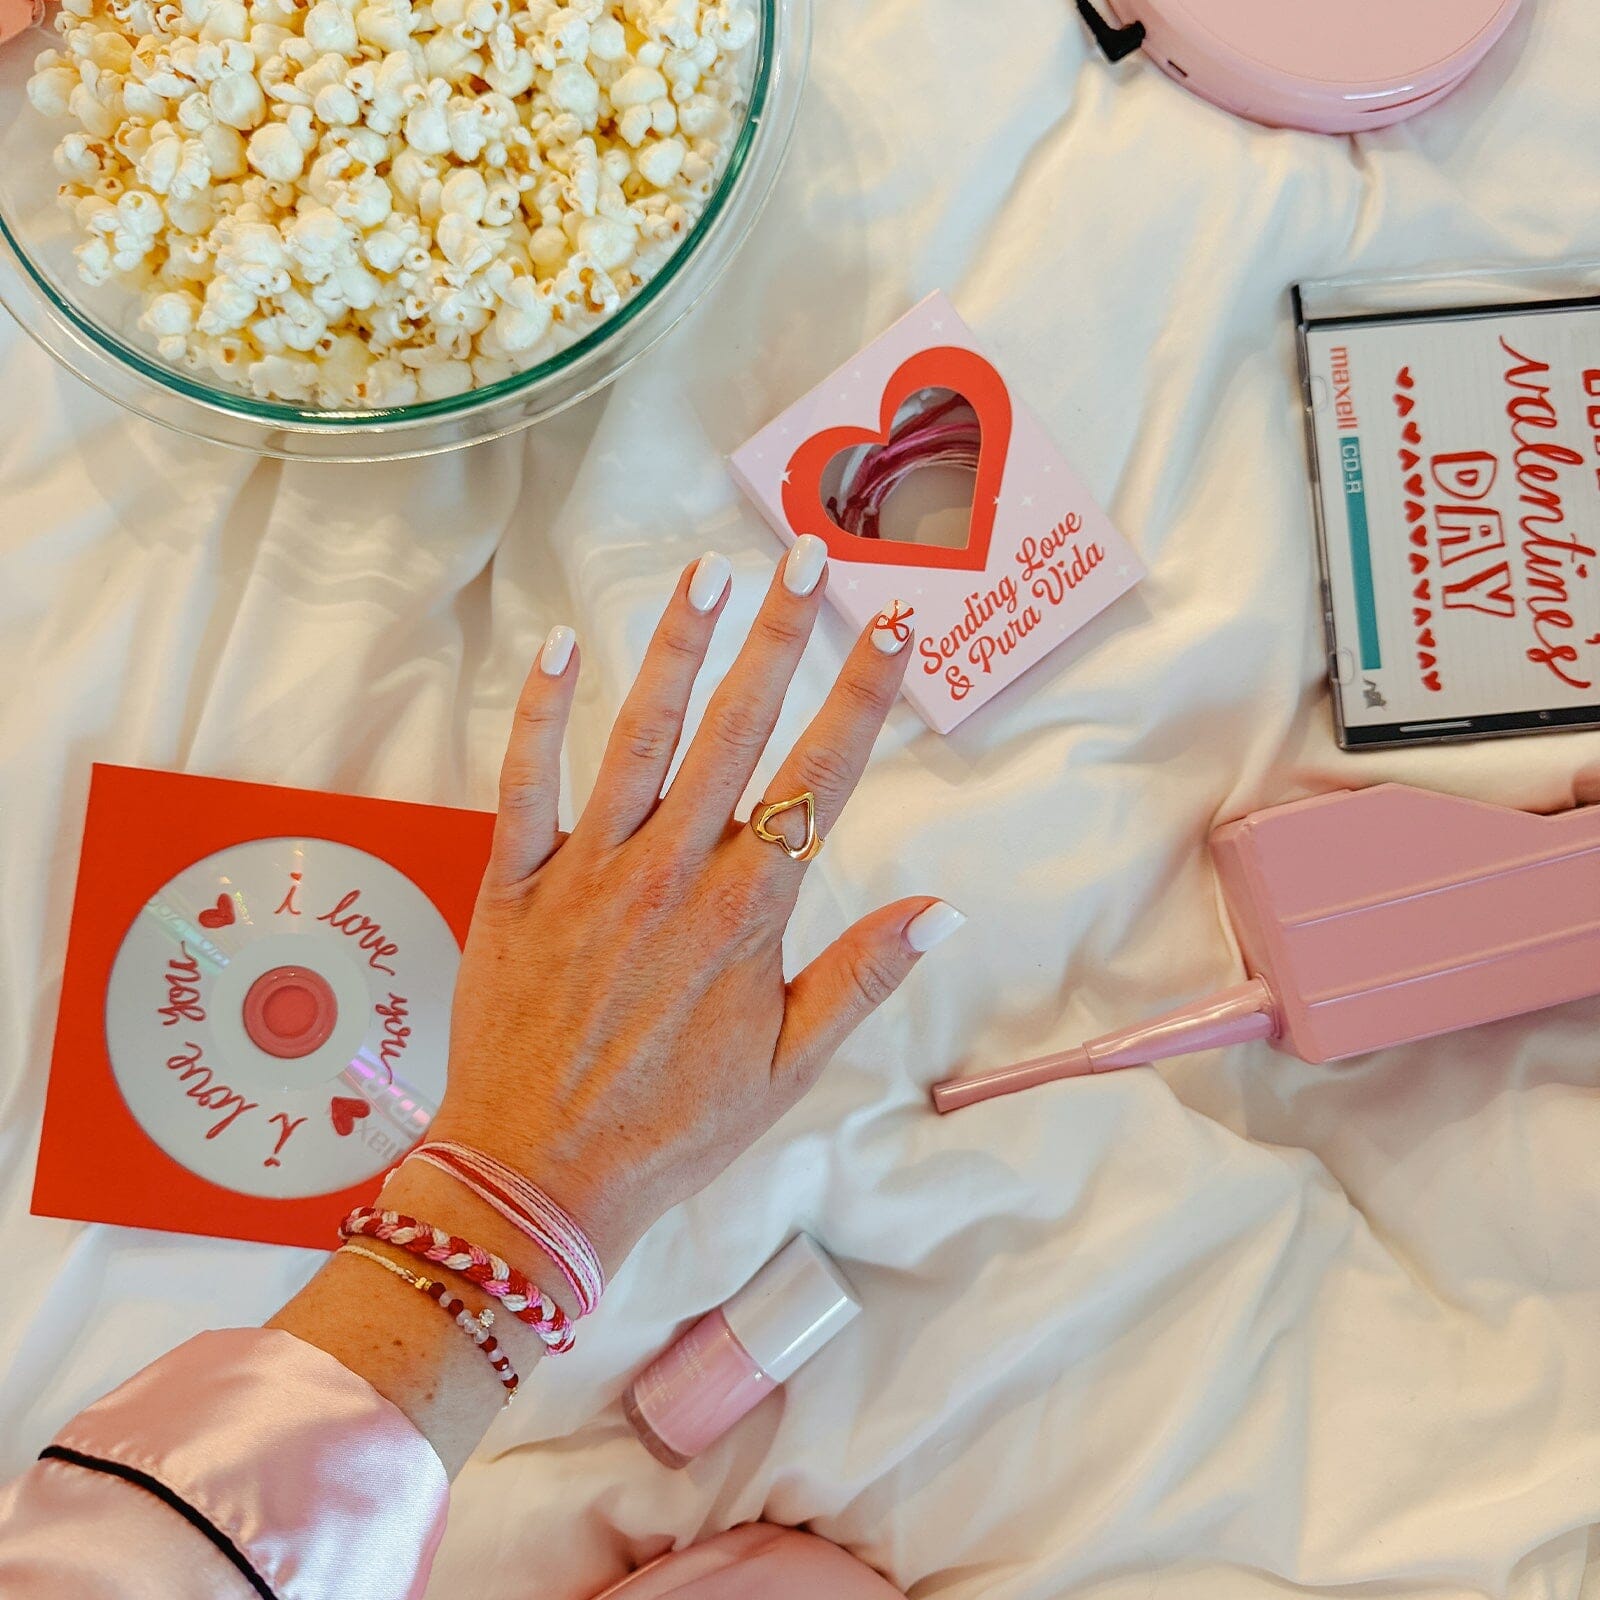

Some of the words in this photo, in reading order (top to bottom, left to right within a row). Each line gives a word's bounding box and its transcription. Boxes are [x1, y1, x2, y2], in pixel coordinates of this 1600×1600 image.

[1330, 346, 1359, 431] maxell
[1340, 444, 1363, 494] CD-R
[1430, 451, 1516, 618] DAY
[919, 575, 1017, 675] Sending
[1015, 511, 1083, 582] Love
[945, 665, 975, 701] &
[968, 605, 1042, 674] Pura
[1031, 541, 1105, 606] Vida
[157, 940, 205, 1025] you
[273, 872, 302, 915] i
[317, 889, 398, 976] love
[375, 992, 412, 1086] you
[167, 1041, 259, 1139] love
[263, 1112, 308, 1169] i
